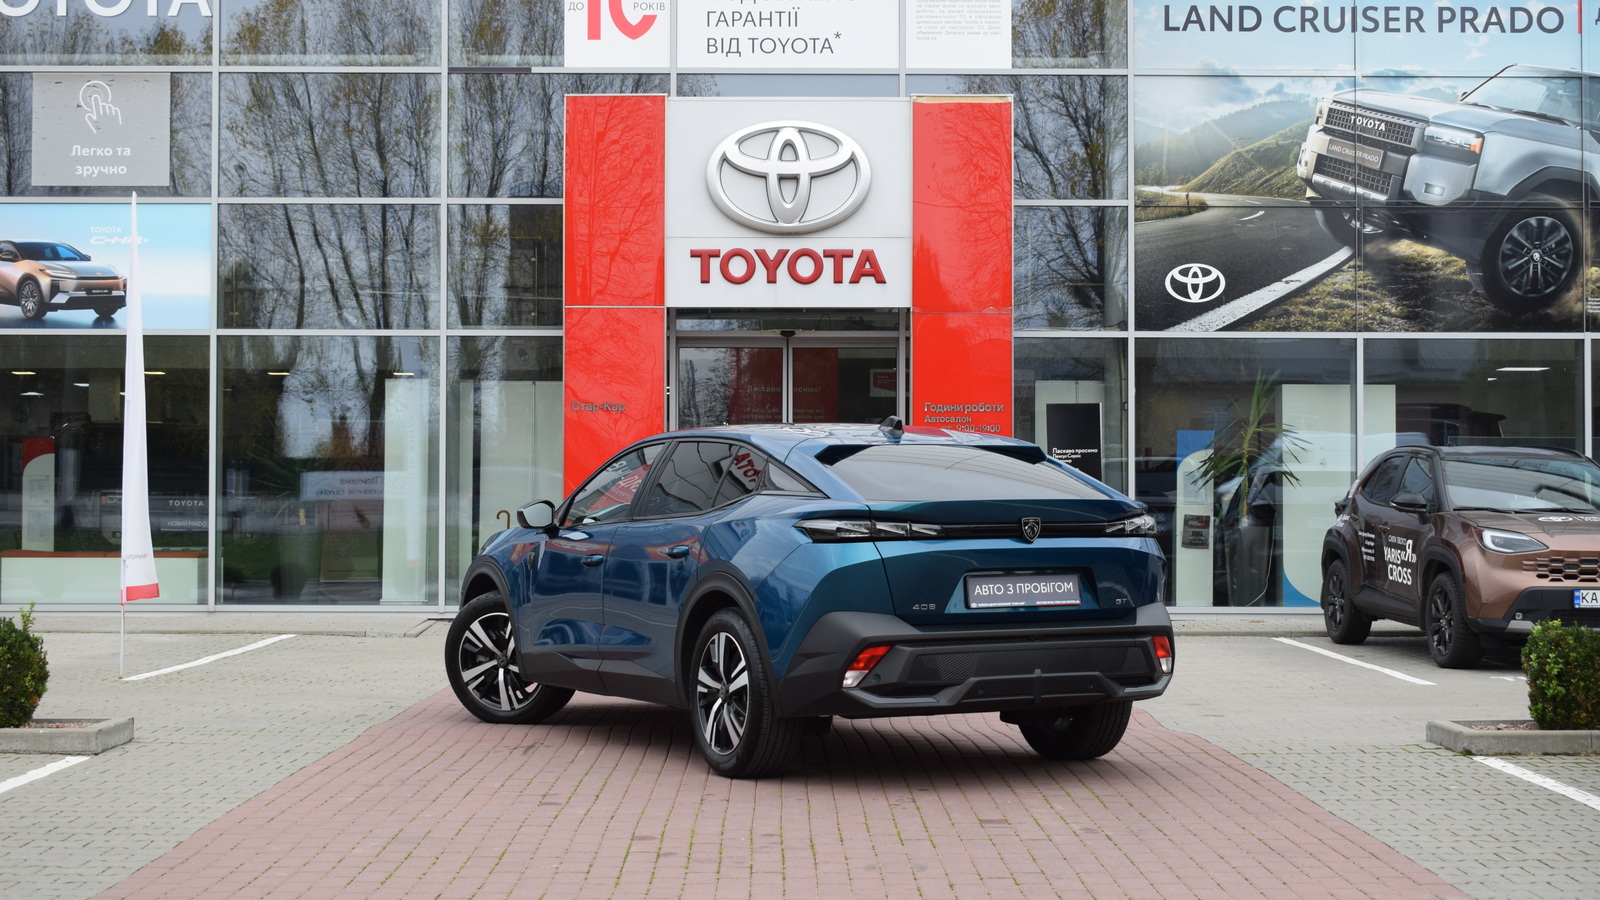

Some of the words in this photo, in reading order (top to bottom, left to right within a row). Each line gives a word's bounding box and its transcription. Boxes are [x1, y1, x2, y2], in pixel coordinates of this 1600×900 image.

[568, 2, 584, 11] ДО
[633, 2, 666, 11] РОКІВ
[706, 6, 800, 27] ГАРАНТІЇ
[1164, 5, 1263, 32] LAND
[1273, 5, 1425, 33] CRUISER
[1437, 6, 1565, 33] PRADO
[706, 37, 742, 58] ВІД
[1351, 116, 1385, 131] TOYOTA
[71, 145, 113, 157] Легко
[116, 147, 131, 156] та
[1329, 144, 1341, 153] LAND
[1342, 148, 1362, 157] CRUISER
[1362, 152, 1379, 163] PRADO
[75, 165, 127, 177] зручно
[690, 248, 886, 285] TOYOTA
[571, 401, 626, 413] Стар-Кар
[924, 402, 963, 414] Години
[964, 402, 1004, 415] роботи
[924, 415, 972, 423] Автосалон
[1384, 546, 1401, 564] YARIS
[1388, 564, 1412, 585] CROSS
[974, 584, 1004, 595] АВТО
[1016, 582, 1074, 594] ПРОБІГОМ
[1581, 592, 1599, 603] KA
